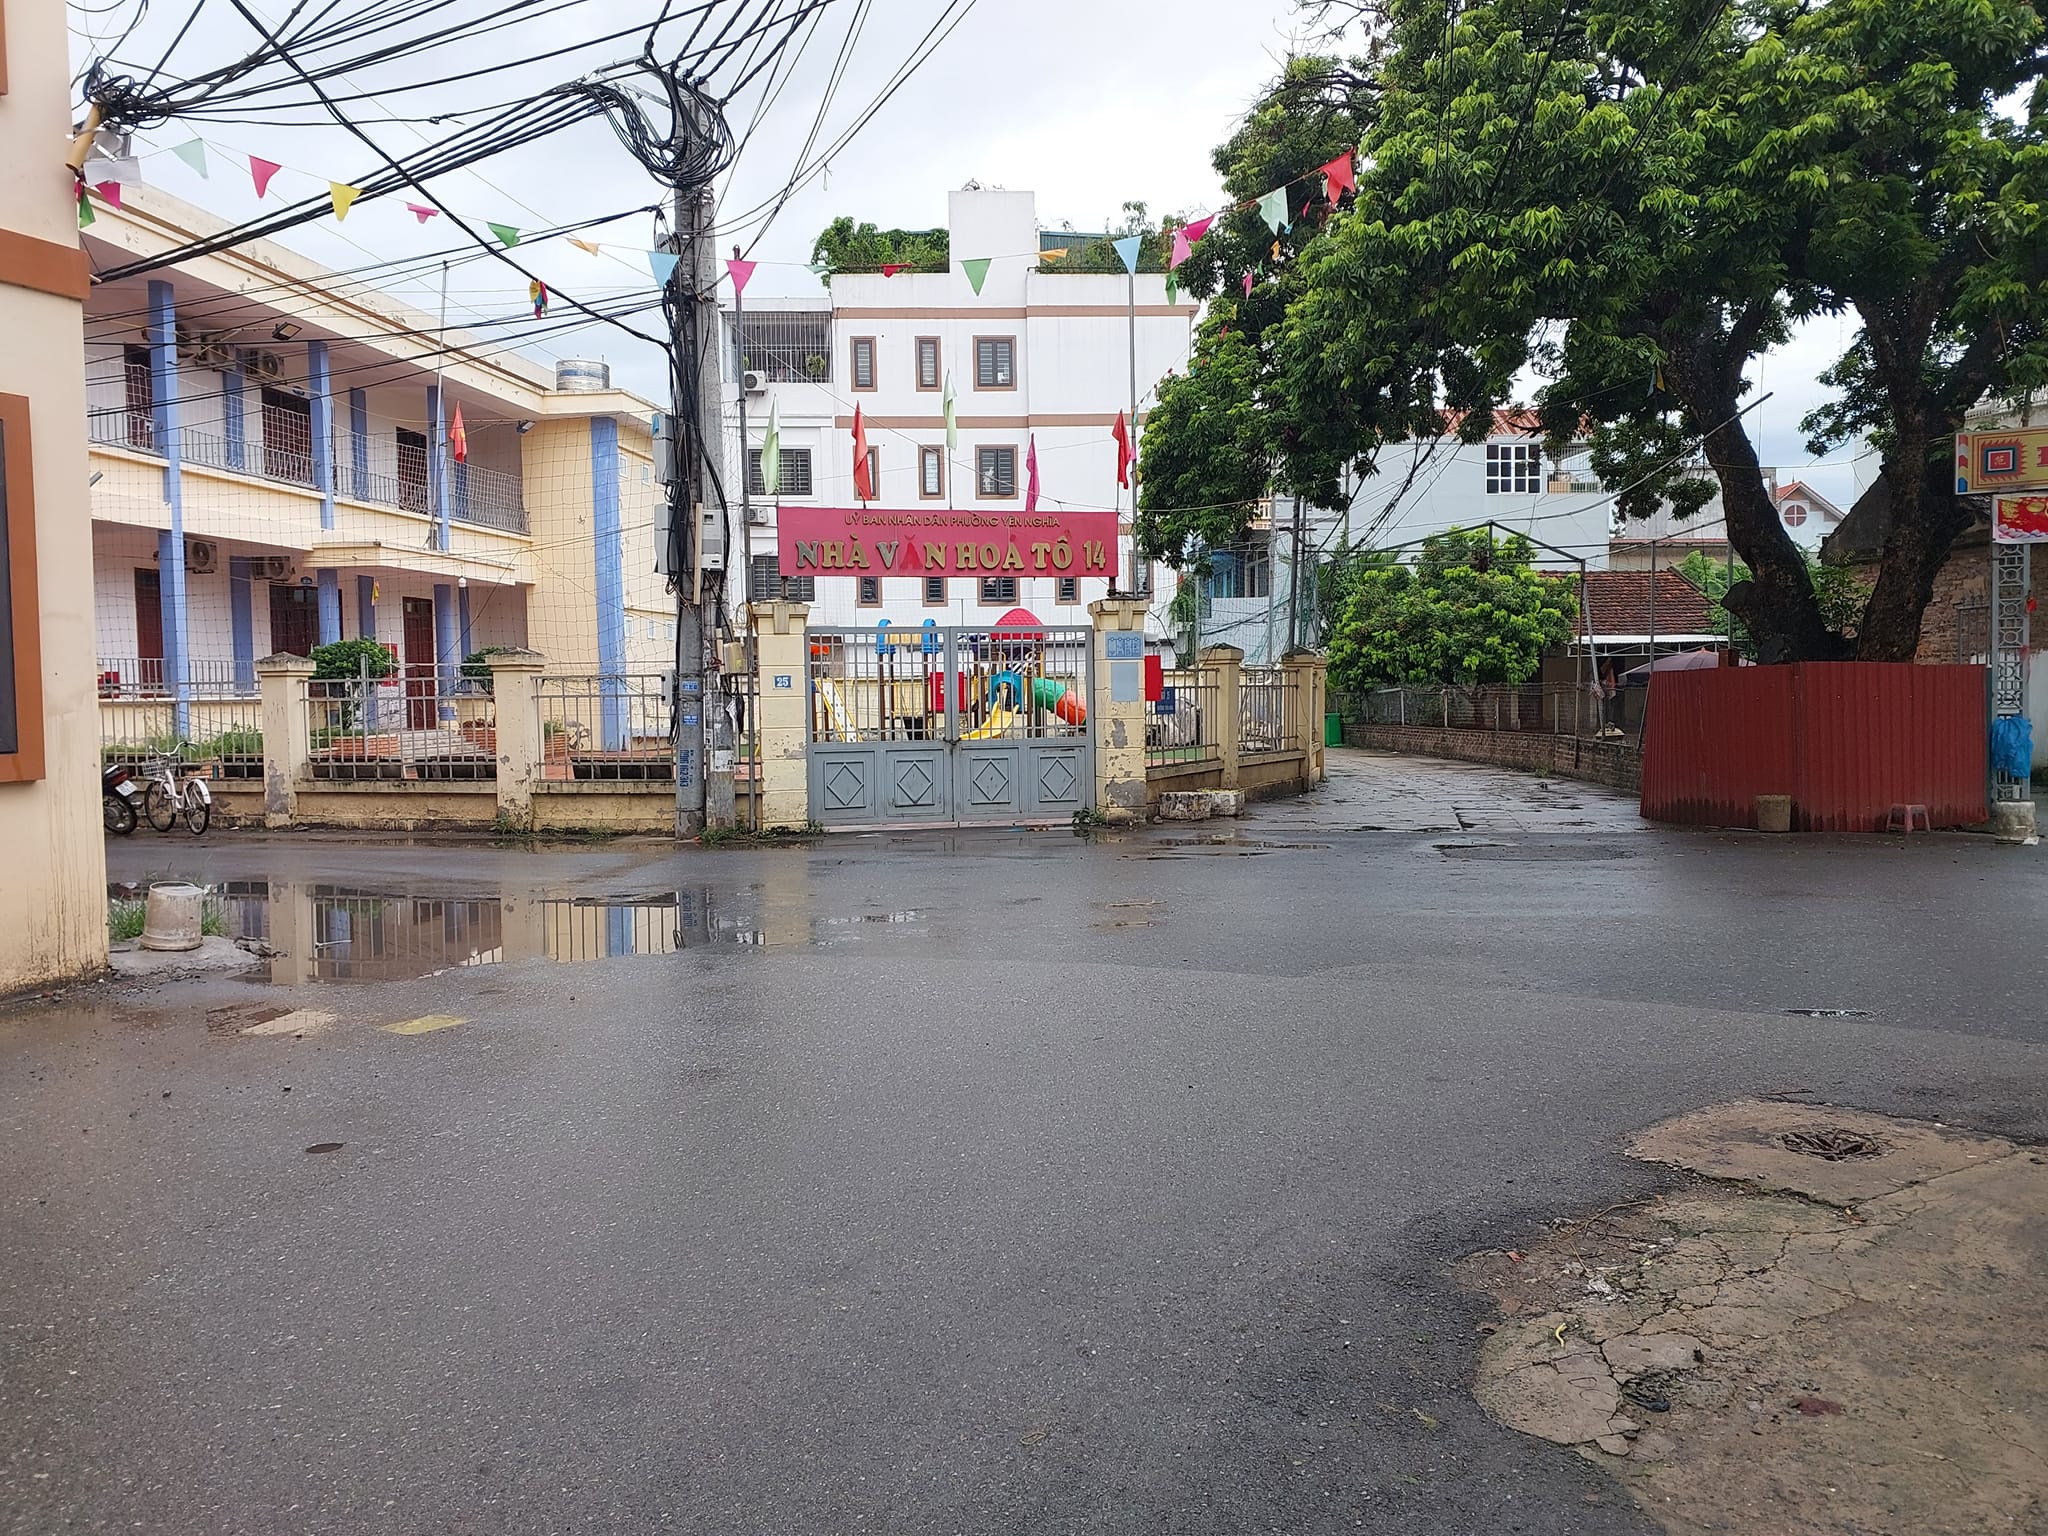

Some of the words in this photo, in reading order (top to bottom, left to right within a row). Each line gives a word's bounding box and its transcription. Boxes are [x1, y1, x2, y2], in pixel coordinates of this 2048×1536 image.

[862, 515, 887, 527] BAN
[888, 515, 922, 527] NHÂN
[924, 515, 949, 527] DÂN
[796, 534, 871, 570] NHÀ
[1083, 540, 1107, 570] 14
[776, 676, 789, 687] 25
